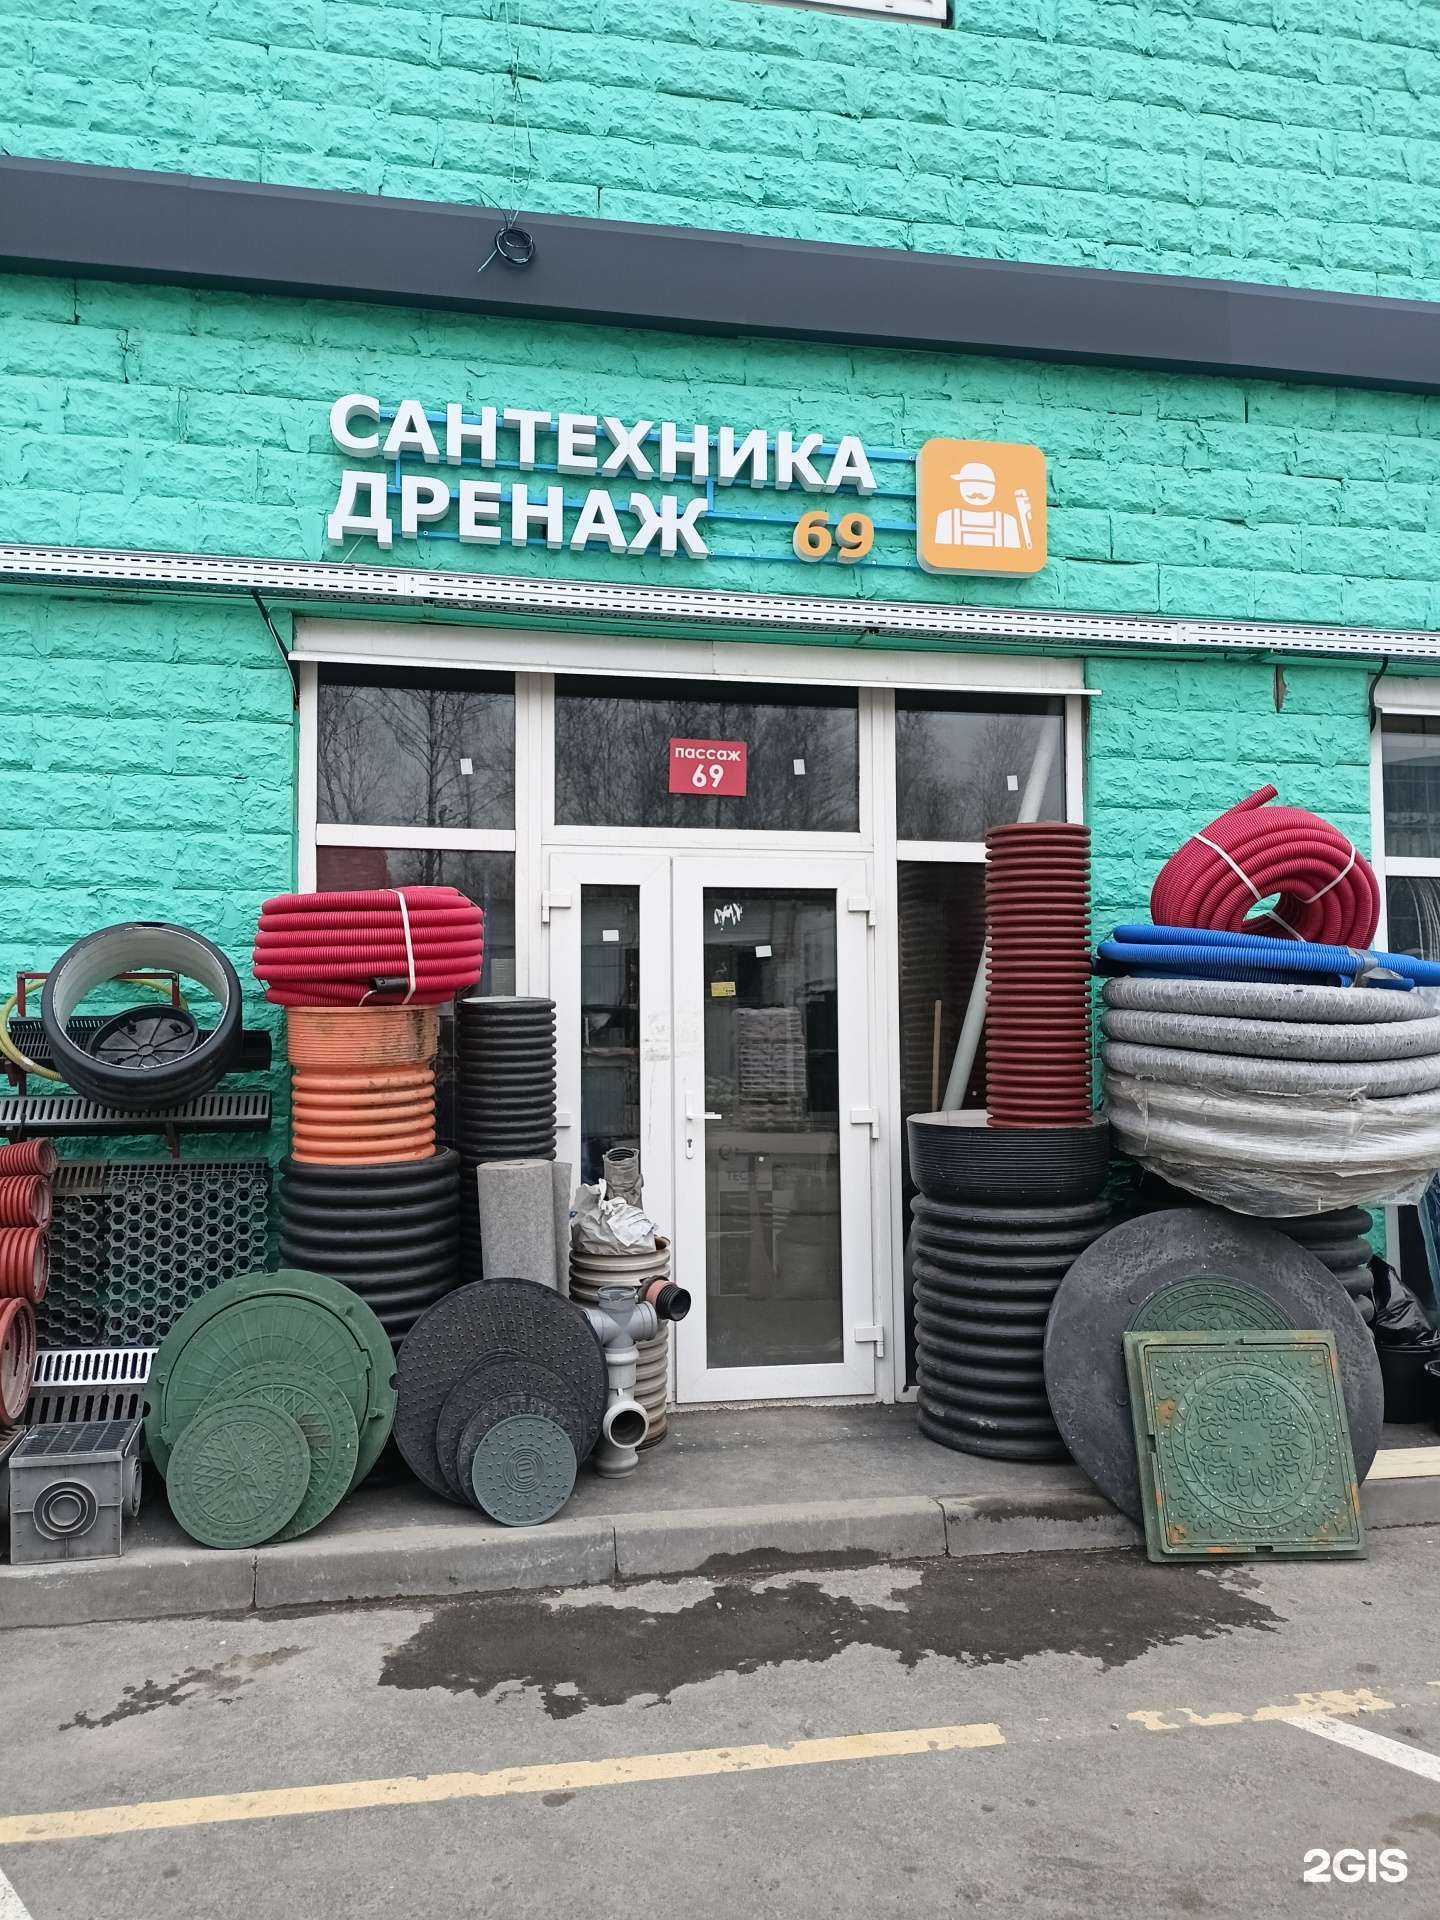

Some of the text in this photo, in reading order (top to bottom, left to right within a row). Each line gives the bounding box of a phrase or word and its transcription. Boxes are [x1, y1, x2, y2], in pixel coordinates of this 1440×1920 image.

[329, 393, 877, 495] САНТЕХНИКА
[327, 470, 874, 564] ДРЕНАЖ 69
[675, 747, 741, 761] пассаж
[692, 763, 724, 788] 69
